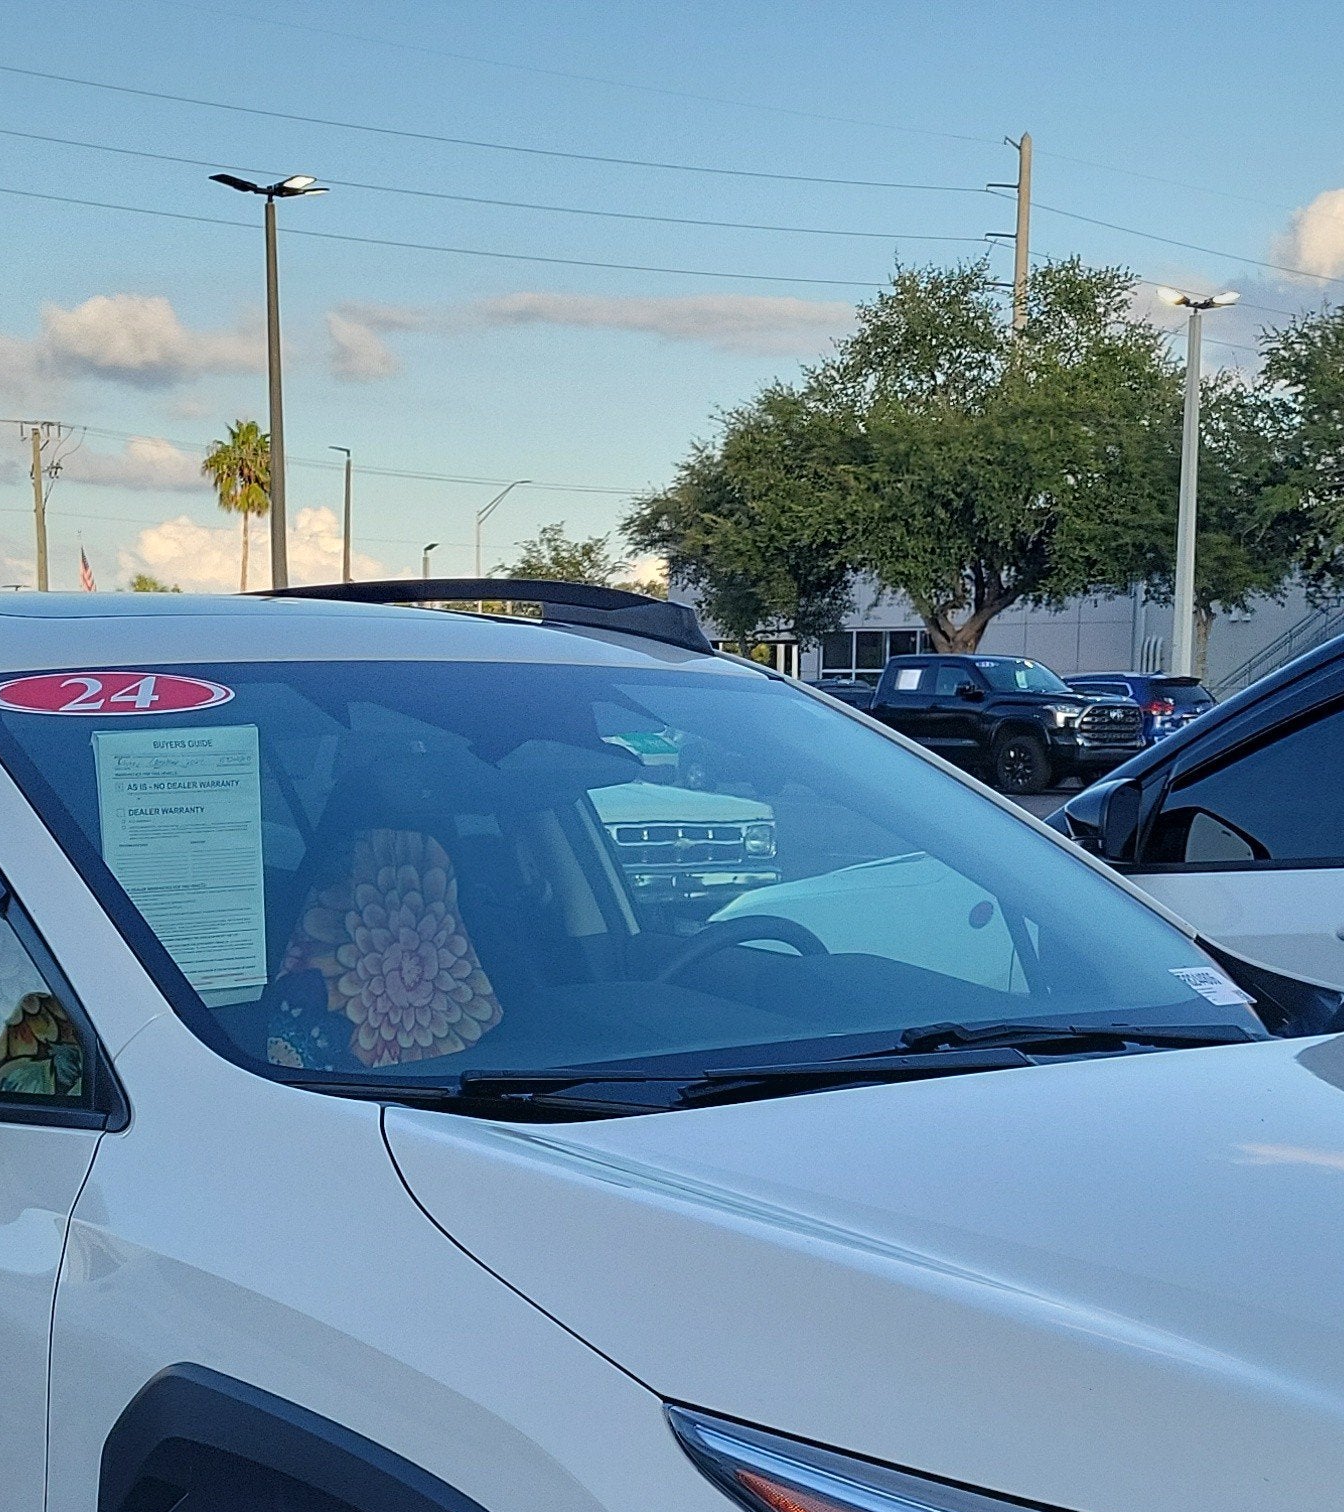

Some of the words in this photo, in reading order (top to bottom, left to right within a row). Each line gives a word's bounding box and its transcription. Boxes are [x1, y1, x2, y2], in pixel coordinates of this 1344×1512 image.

[58, 675, 160, 712] 24
[188, 739, 213, 748] GUIDE
[126, 783, 138, 791] AS
[139, 783, 148, 791] IS
[154, 782, 165, 791] NO
[167, 781, 198, 790] DEALER
[199, 780, 240, 789] WARRANTY
[128, 808, 161, 817] DEALER
[161, 806, 205, 815] WARRANTY
